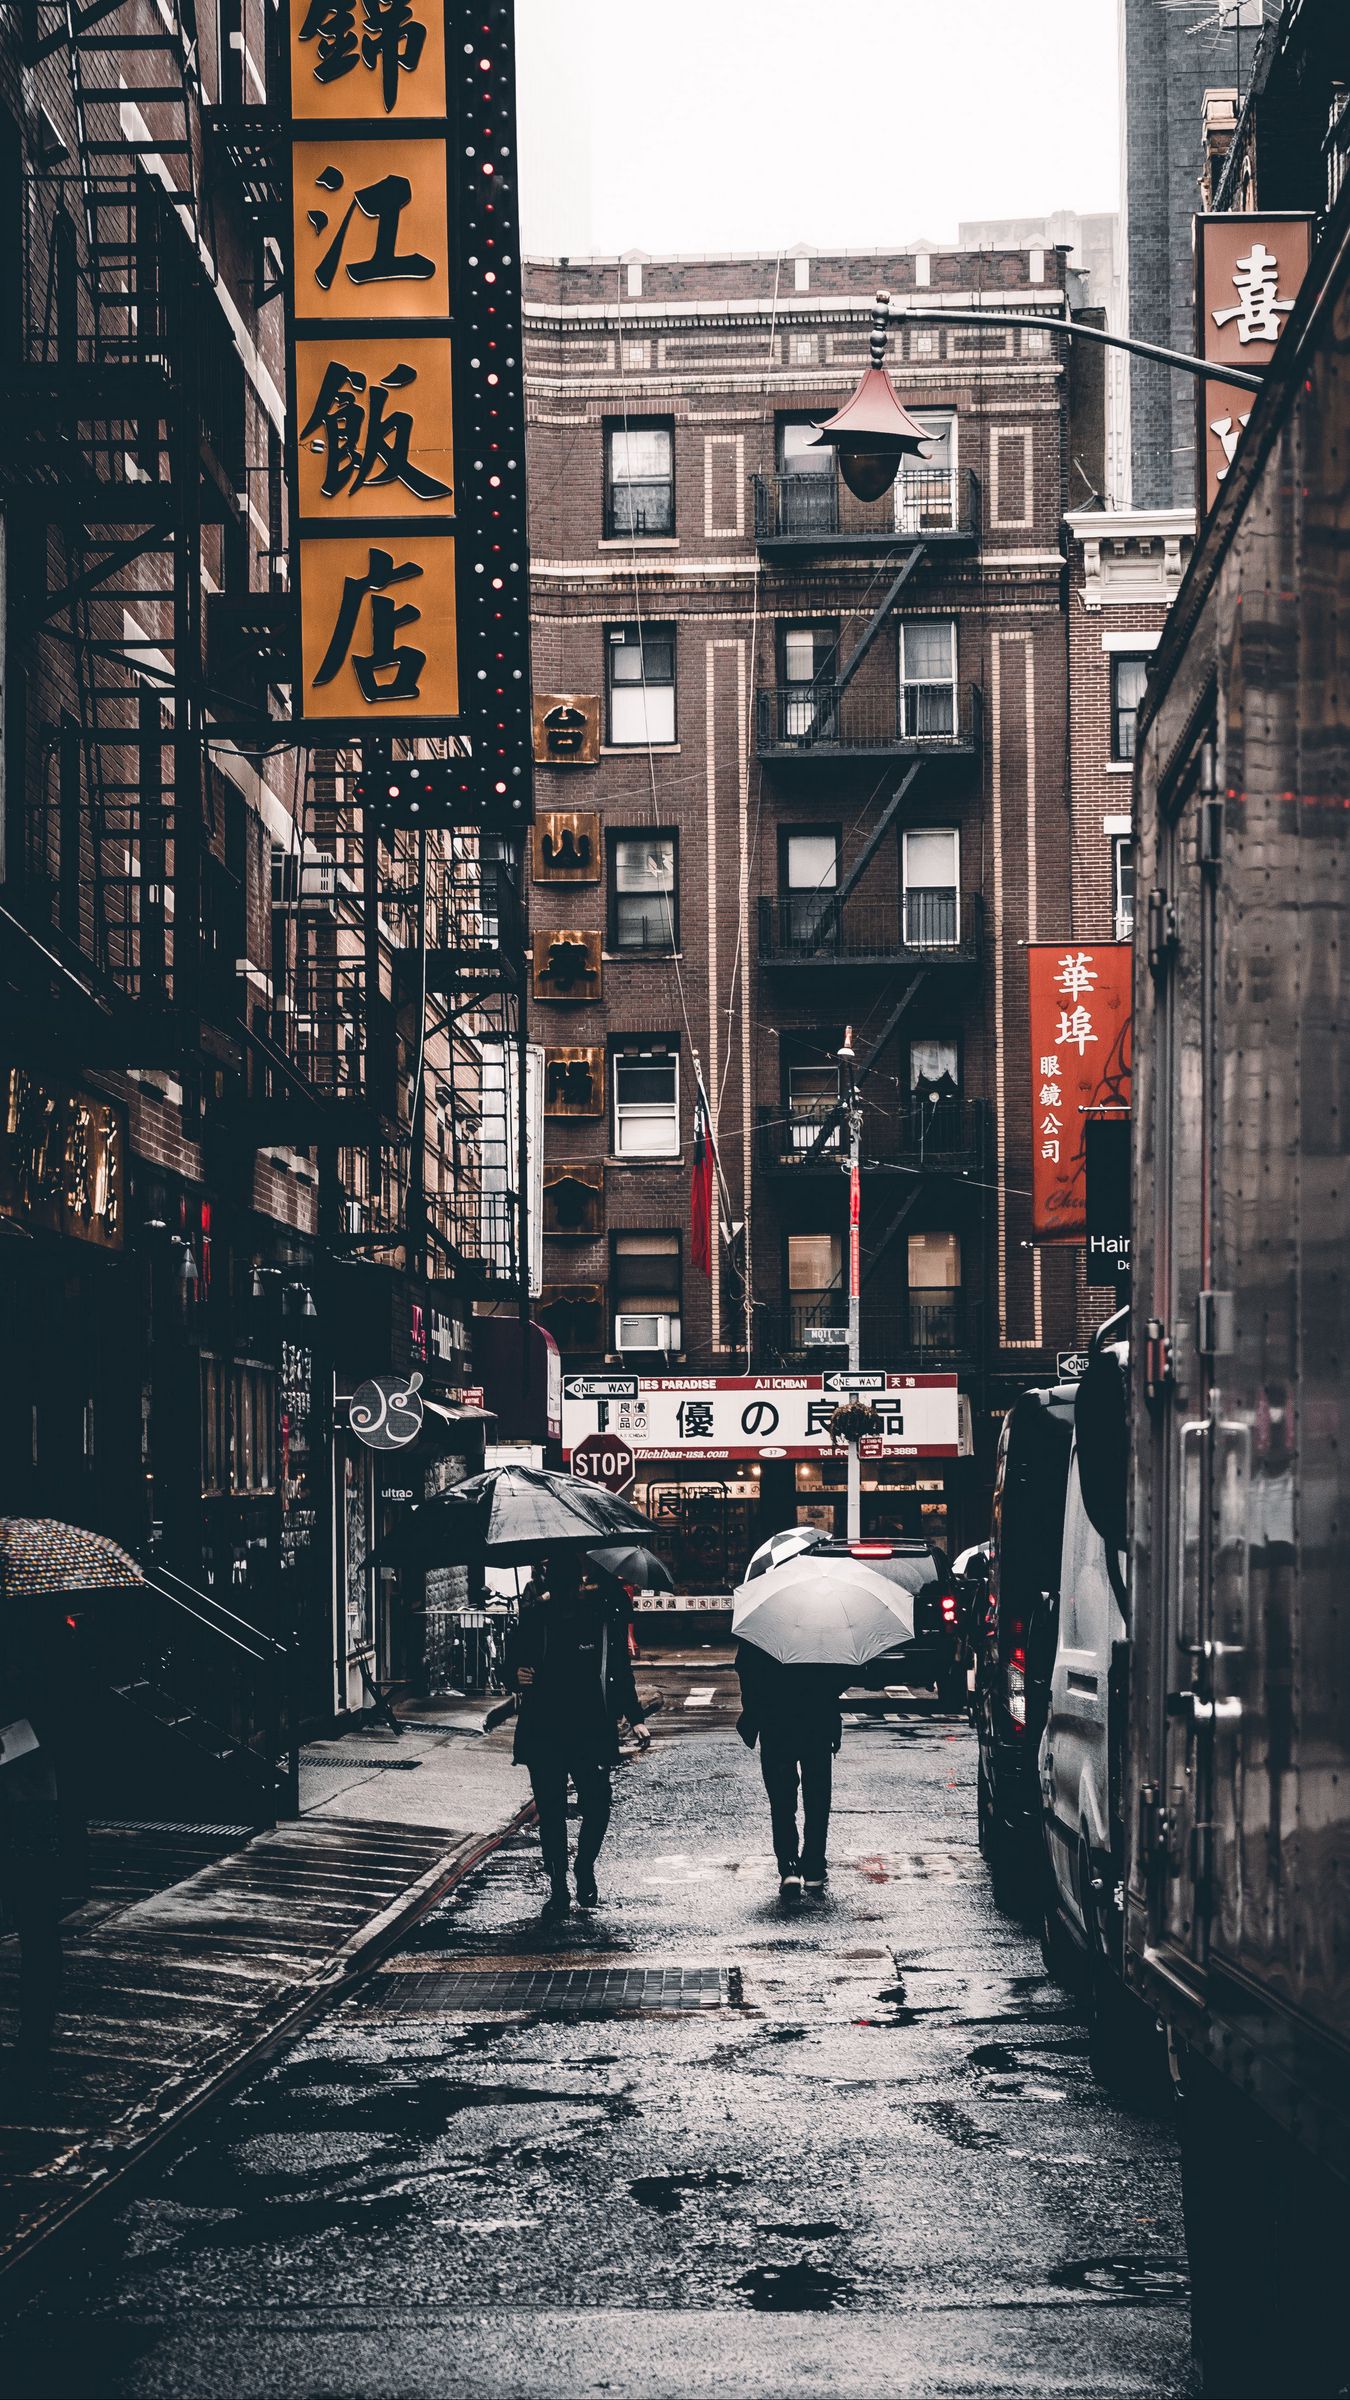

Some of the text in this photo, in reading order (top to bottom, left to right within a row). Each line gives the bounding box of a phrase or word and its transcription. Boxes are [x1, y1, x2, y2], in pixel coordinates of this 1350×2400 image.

[1052, 952, 1099, 1057] 華埠
[1039, 1055, 1063, 1164] 眼鏡公司
[1090, 1235, 1131, 1253] Hair
[811, 1330, 832, 1339] MOTT
[639, 1379, 717, 1390] IES PARADISE
[754, 1378, 807, 1389] AJI ICHIBAN
[833, 1377, 878, 1386] ONE WAY
[891, 1376, 916, 1387] 天地
[573, 1383, 631, 1393] ONE WAY
[676, 1398, 904, 1438] 優の良品
[575, 1453, 630, 1476] STOP
